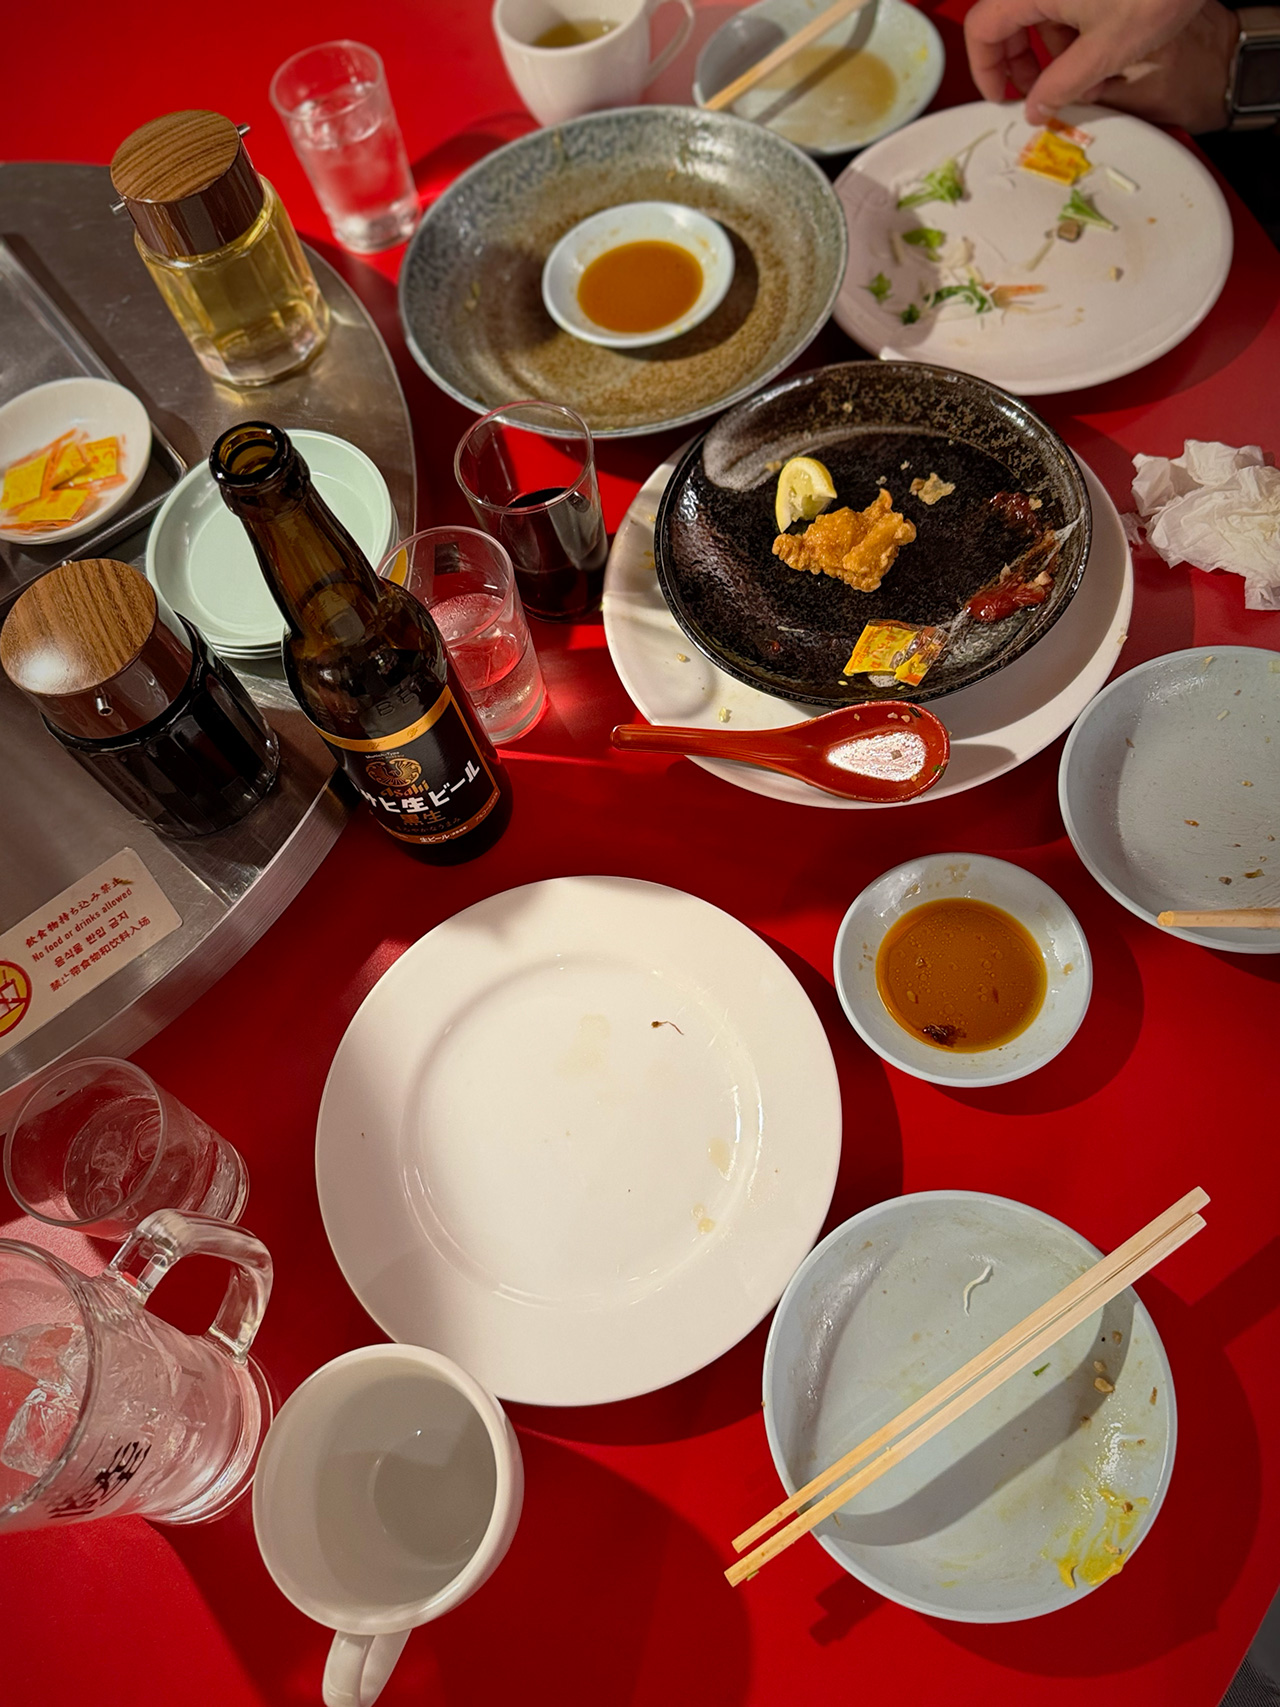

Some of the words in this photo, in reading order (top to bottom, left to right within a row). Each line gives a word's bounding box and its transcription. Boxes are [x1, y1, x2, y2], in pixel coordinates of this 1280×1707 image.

[380, 780, 430, 797] Asahi
[26, 877, 123, 948] 飲食物持ち込み禁止
[32, 951, 45, 962] No
[44, 936, 64, 953] food
[65, 930, 74, 940] or
[75, 912, 101, 932] drinks
[102, 888, 132, 913] allowed
[54, 942, 83, 968] 음식물
[85, 926, 107, 945] 반입
[108, 910, 129, 929] 금지
